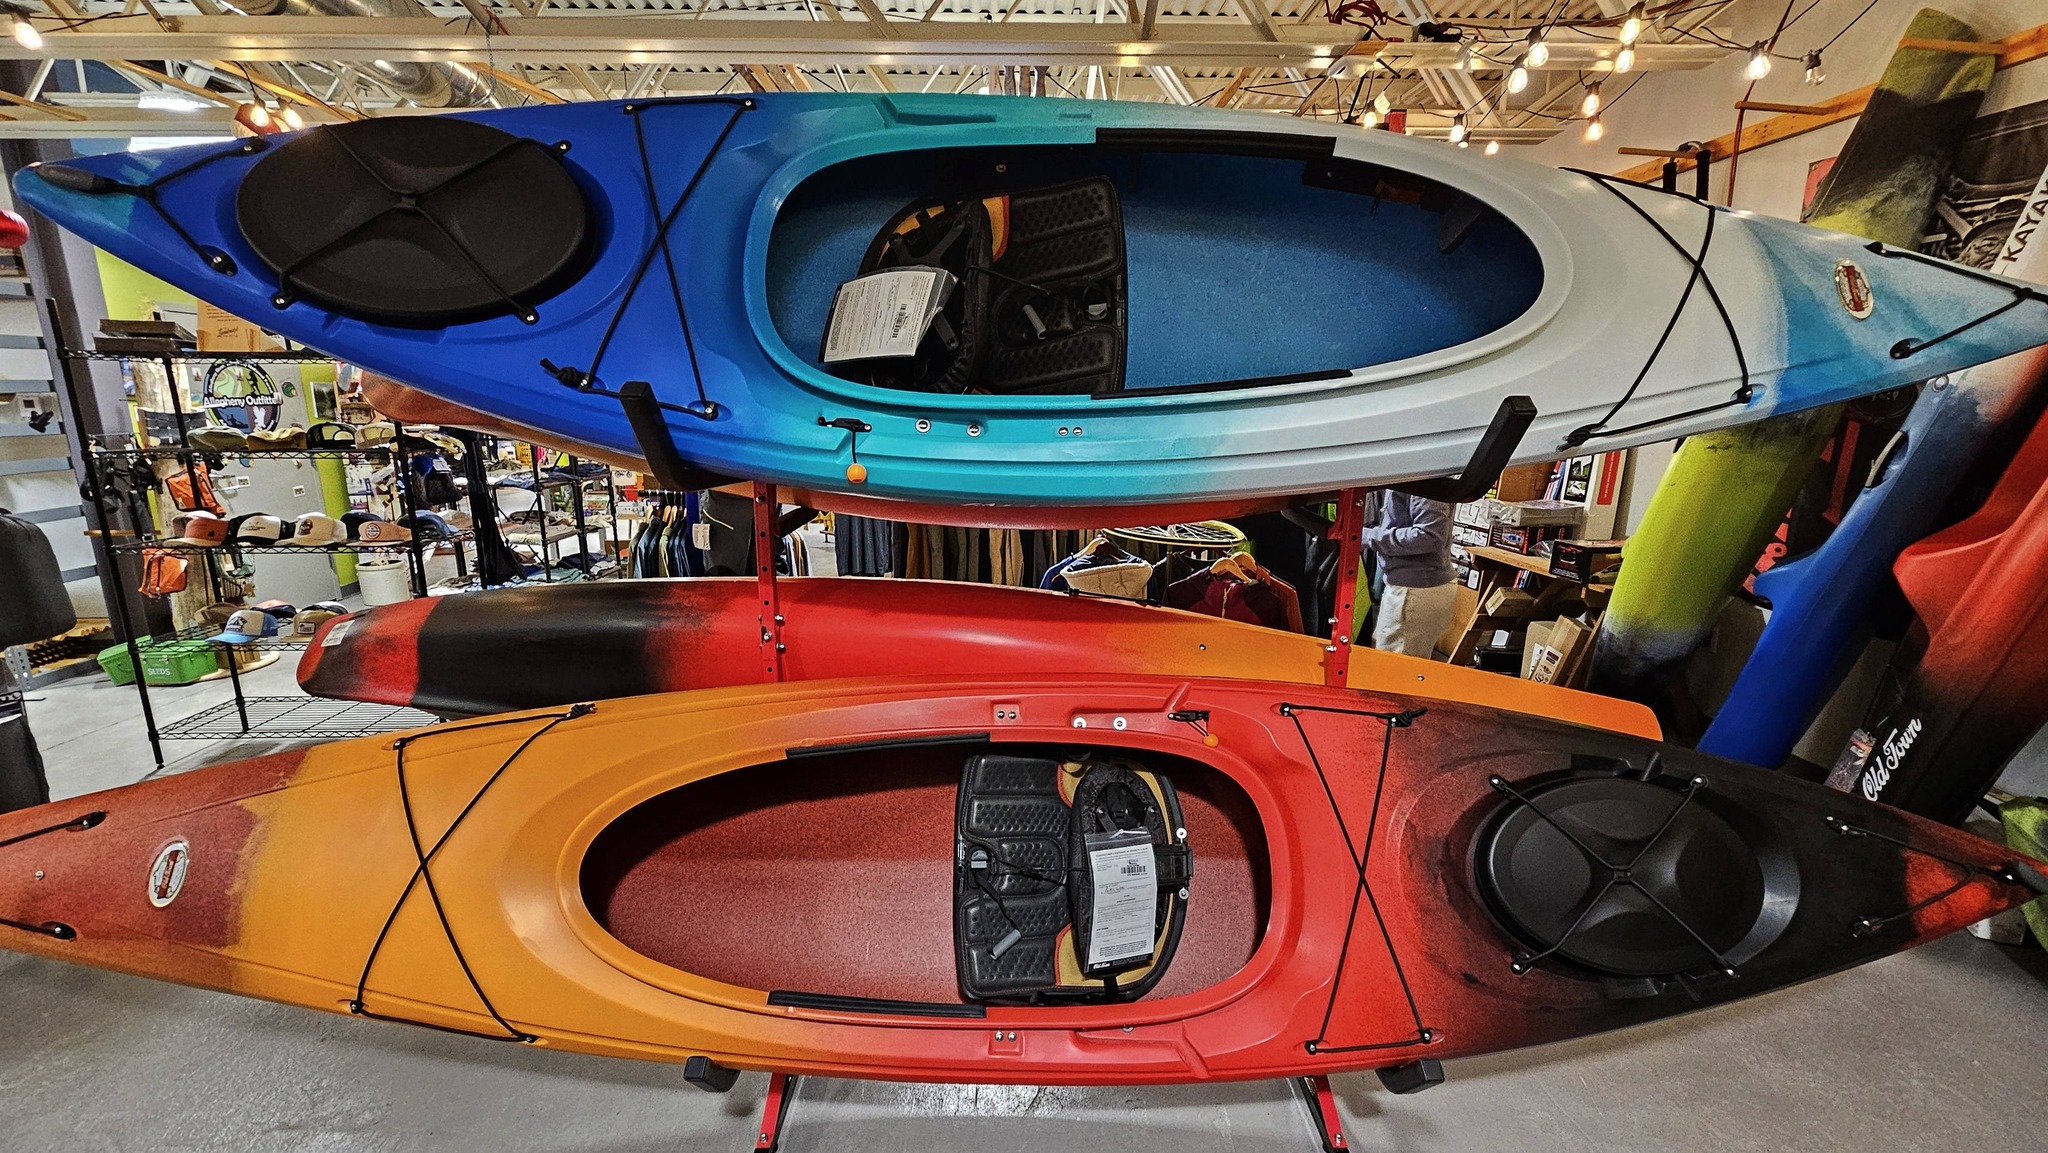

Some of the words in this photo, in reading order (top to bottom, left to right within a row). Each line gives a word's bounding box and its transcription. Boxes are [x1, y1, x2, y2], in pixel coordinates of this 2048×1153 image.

[204, 396, 245, 407] Allegheny
[147, 667, 171, 676] SEEDS
[1862, 755, 1890, 802] Old
[1882, 718, 1922, 770] Town
